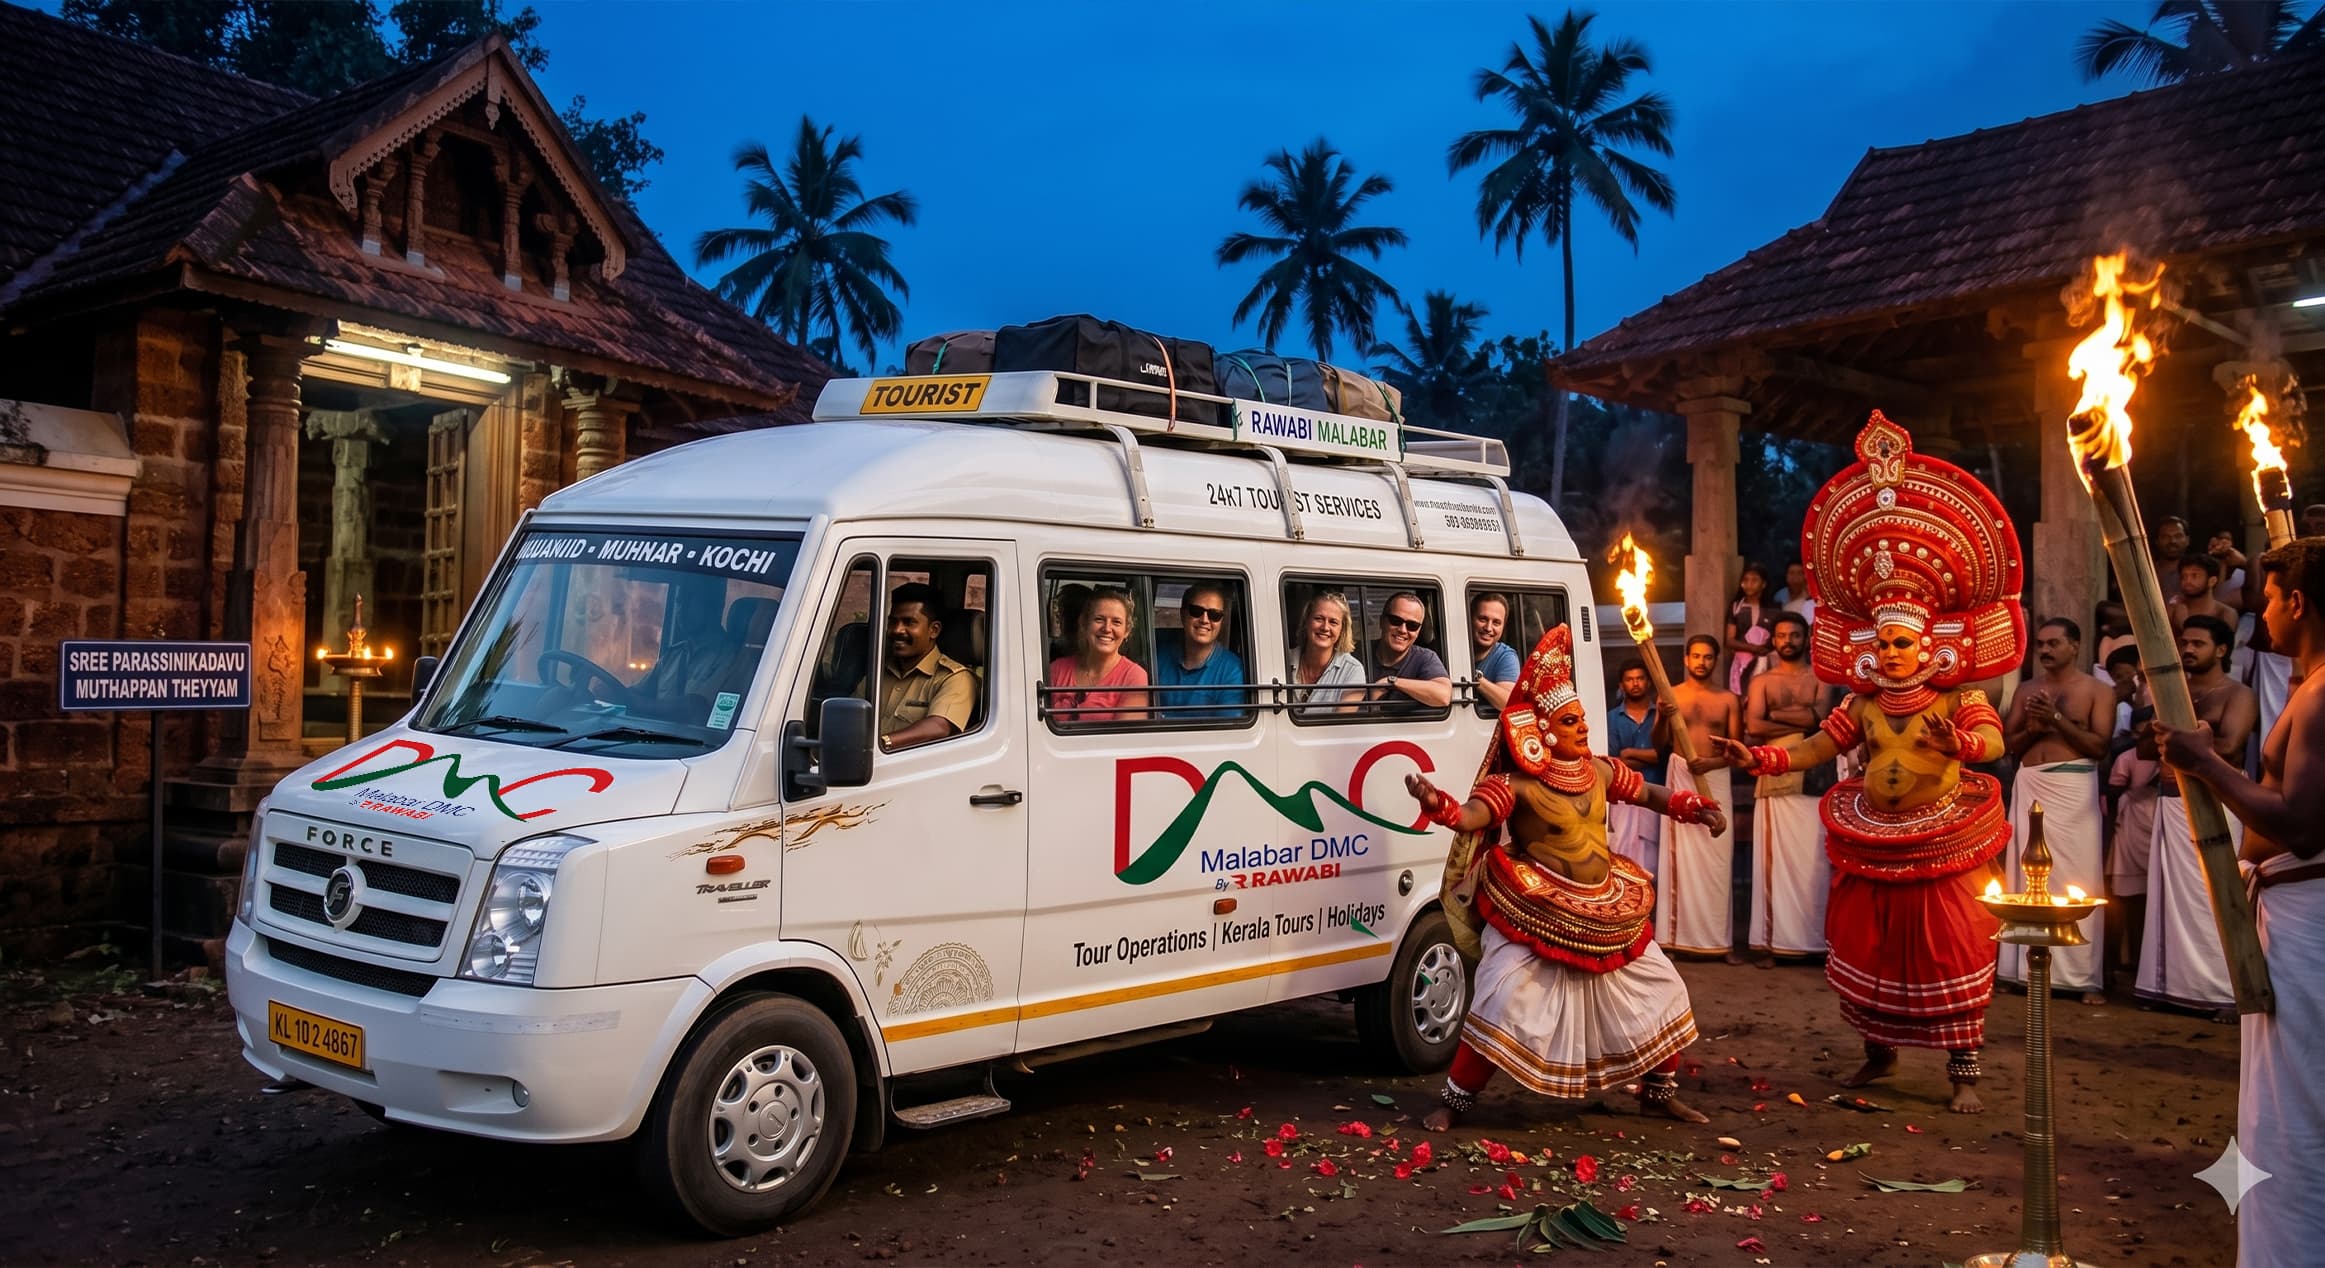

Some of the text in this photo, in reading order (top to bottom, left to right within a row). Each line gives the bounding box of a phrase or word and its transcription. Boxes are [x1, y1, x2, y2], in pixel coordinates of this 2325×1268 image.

[872, 382, 981, 407] TOURIST
[1251, 410, 1388, 450] RAWABI MALABAR
[1314, 493, 1382, 519] SERVICES
[597, 540, 683, 564] MUHNAR
[698, 545, 776, 574] KOCHI
[69, 652, 245, 672] SREE PARASSINIKADAVU
[76, 678, 238, 699] MUTHAPPAN THEYYAM
[306, 825, 393, 857] FORCE
[1201, 834, 1369, 873] Malabar DMC
[1215, 878, 1230, 892] By
[1252, 863, 1341, 888] RAWABI
[1073, 941, 1112, 967] Tour
[1117, 929, 1207, 964] Operations
[1222, 916, 1270, 945] Kerala
[1274, 912, 1314, 936] Tours
[1327, 901, 1385, 929] Holidays
[275, 1011, 291, 1039] KL
[312, 1024, 320, 1048] 2
[322, 1027, 358, 1059] 4867
